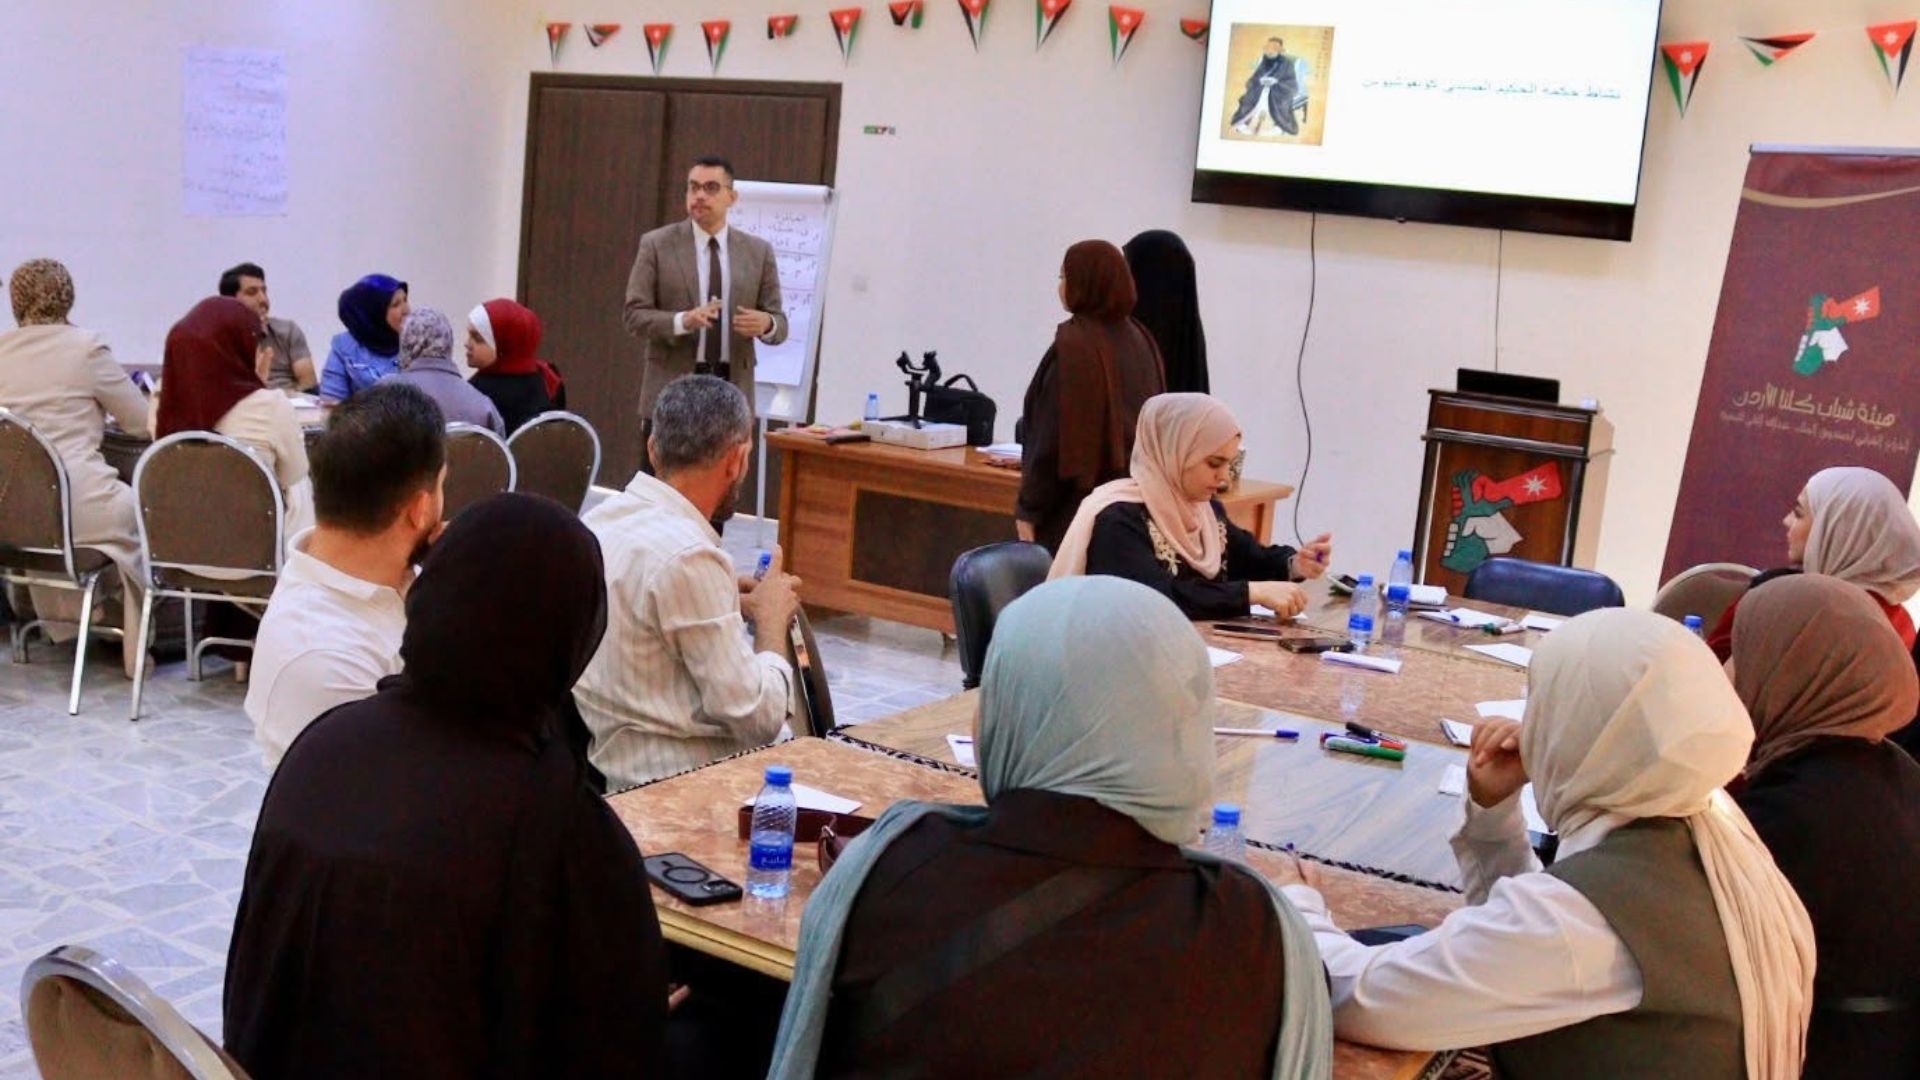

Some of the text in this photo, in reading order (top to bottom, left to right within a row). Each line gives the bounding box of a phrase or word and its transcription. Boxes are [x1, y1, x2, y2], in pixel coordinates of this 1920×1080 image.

[1732, 382, 1896, 430] هيئة شباب كلنا الأردن
